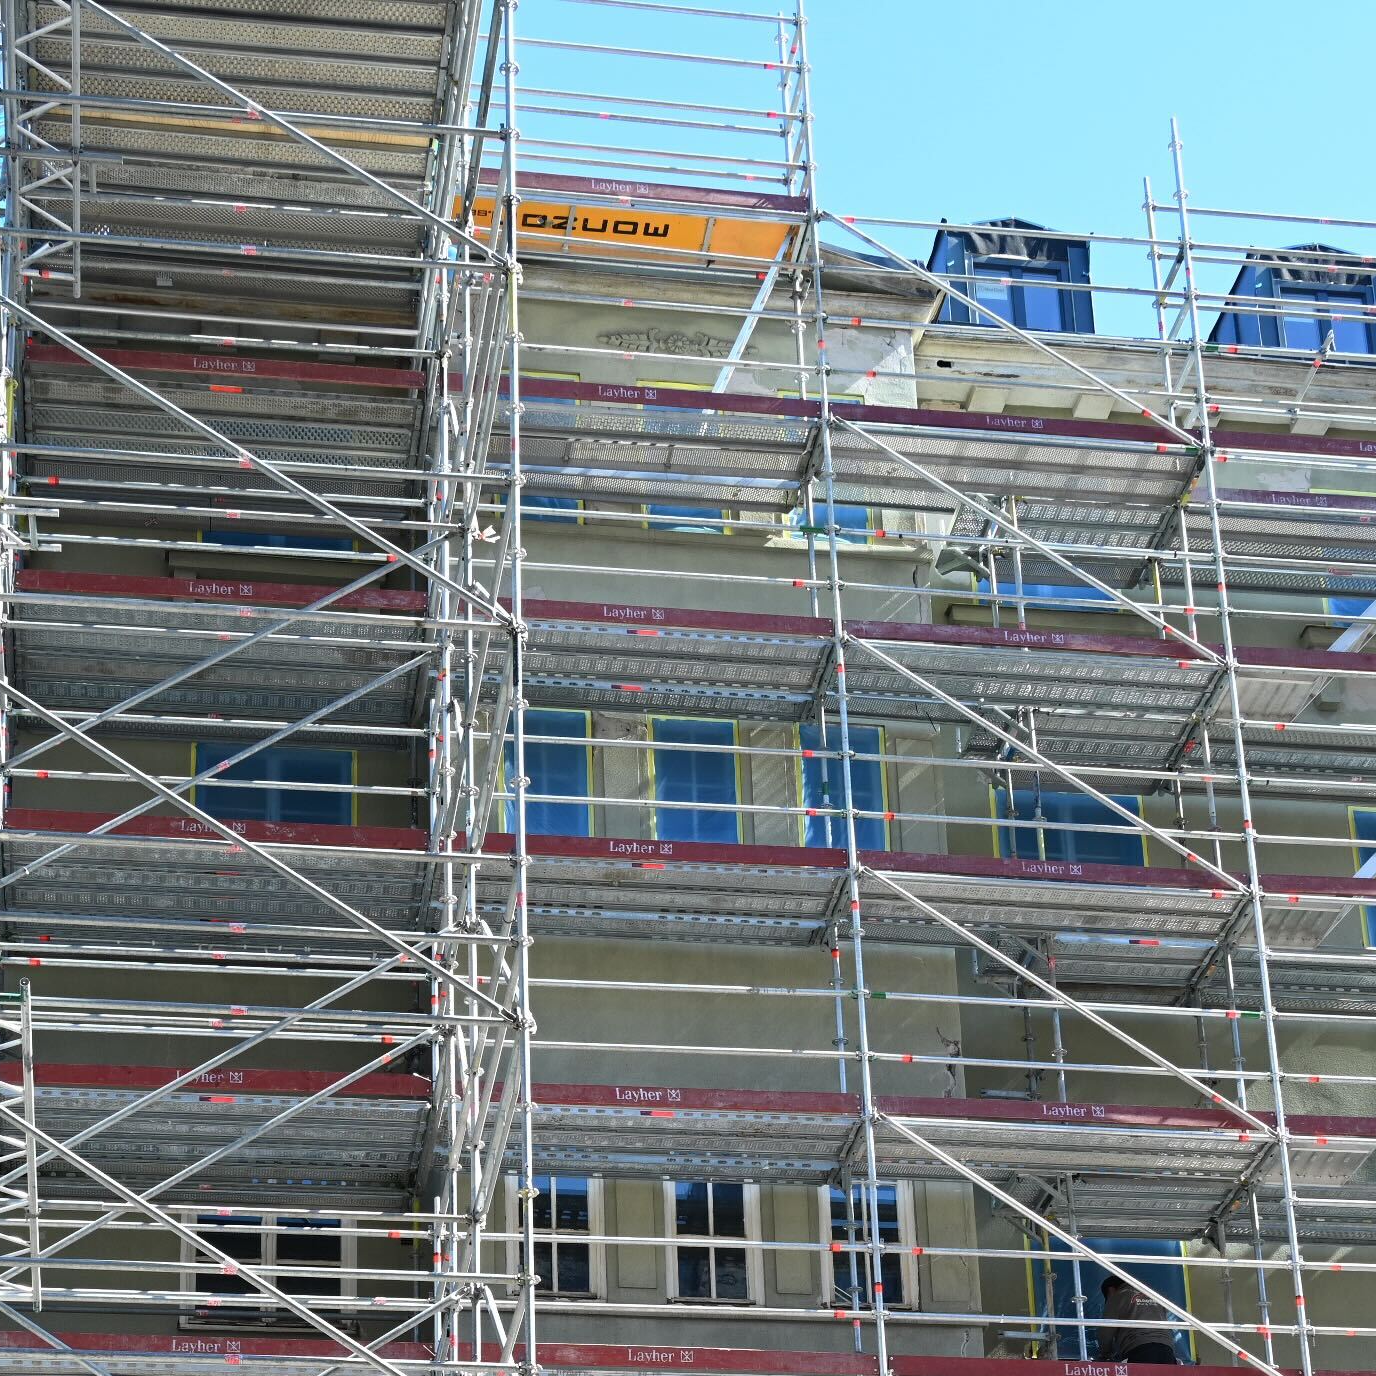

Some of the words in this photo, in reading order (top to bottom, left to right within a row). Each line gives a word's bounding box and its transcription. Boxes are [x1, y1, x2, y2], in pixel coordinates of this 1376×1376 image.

[591, 179, 632, 193] Layher
[193, 358, 237, 373] Layher
[598, 386, 640, 400] Layher
[986, 416, 1026, 429] Layher
[190, 582, 235, 598] Layher
[603, 606, 647, 620] Layher
[1004, 631, 1046, 645] Layher
[610, 841, 654, 855] Layher
[1021, 862, 1064, 876] Layher
[615, 1087, 662, 1103] Layher
[1043, 1104, 1086, 1117] Layher
[172, 1339, 220, 1354] Layher
[627, 1349, 675, 1364] Layher
